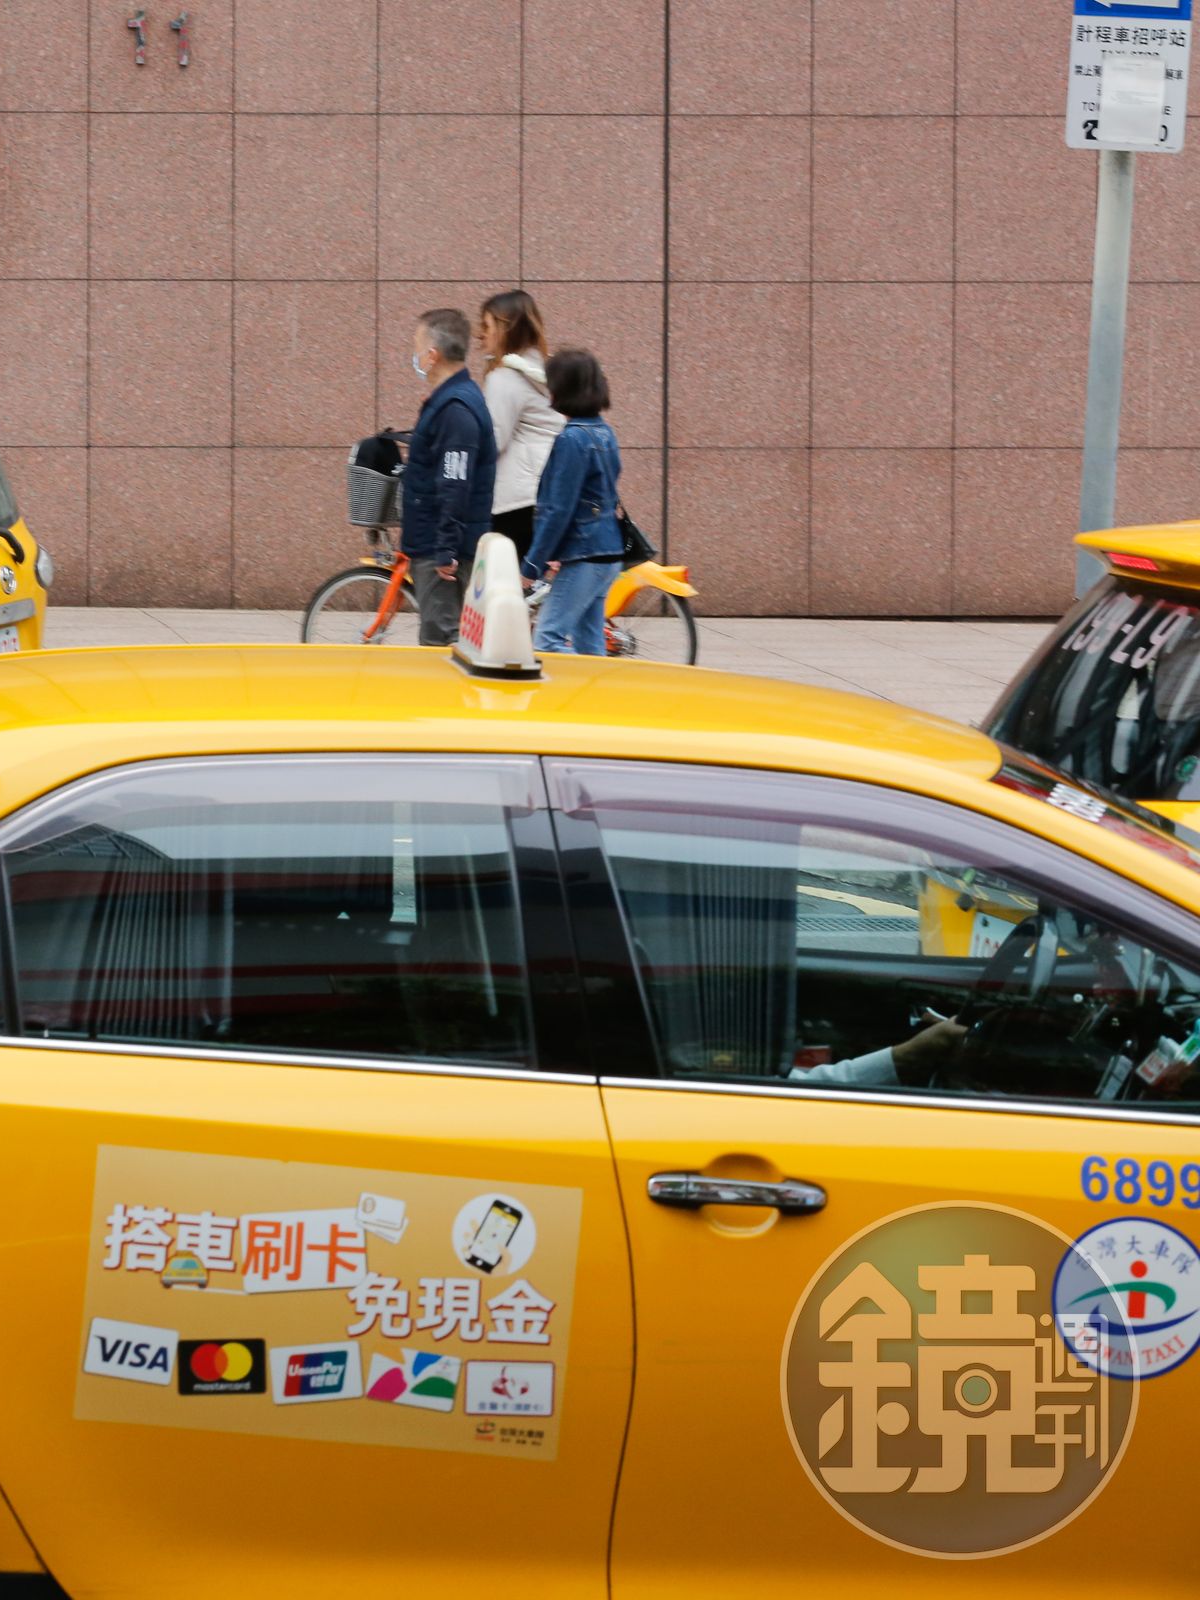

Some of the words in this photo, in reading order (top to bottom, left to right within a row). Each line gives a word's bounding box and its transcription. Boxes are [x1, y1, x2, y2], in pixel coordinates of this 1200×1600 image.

[1076, 24, 1187, 47] 計程車招呼站
[1080, 1155, 1200, 1210] 6899
[103, 1203, 367, 1284] 搭車刷卡
[347, 1272, 556, 1345] 免現金
[94, 1335, 169, 1373] VISA
[1142, 1334, 1186, 1365] TAXI
[194, 1381, 251, 1392] mastercard
[288, 1361, 345, 1378] UnionPay
